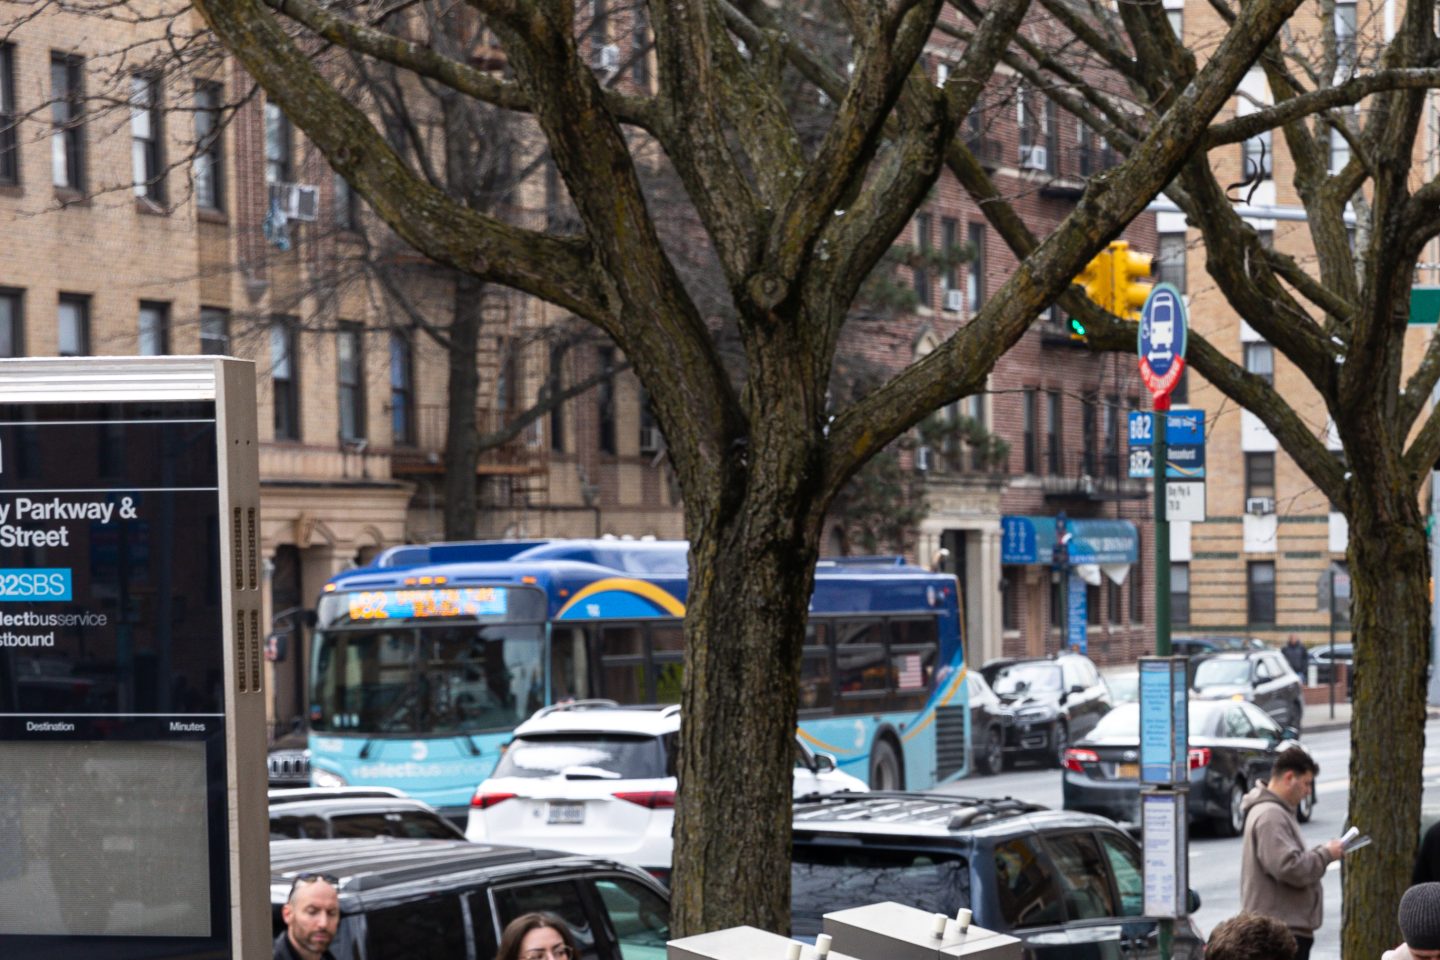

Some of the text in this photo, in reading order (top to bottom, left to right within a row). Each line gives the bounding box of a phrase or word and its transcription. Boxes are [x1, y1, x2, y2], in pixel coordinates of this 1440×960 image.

[16, 498, 114, 524] Parkway
[119, 497, 138, 520] &
[0, 525, 69, 548] Street
[26, 722, 75, 733] Destination
[169, 720, 206, 733] Minutes
